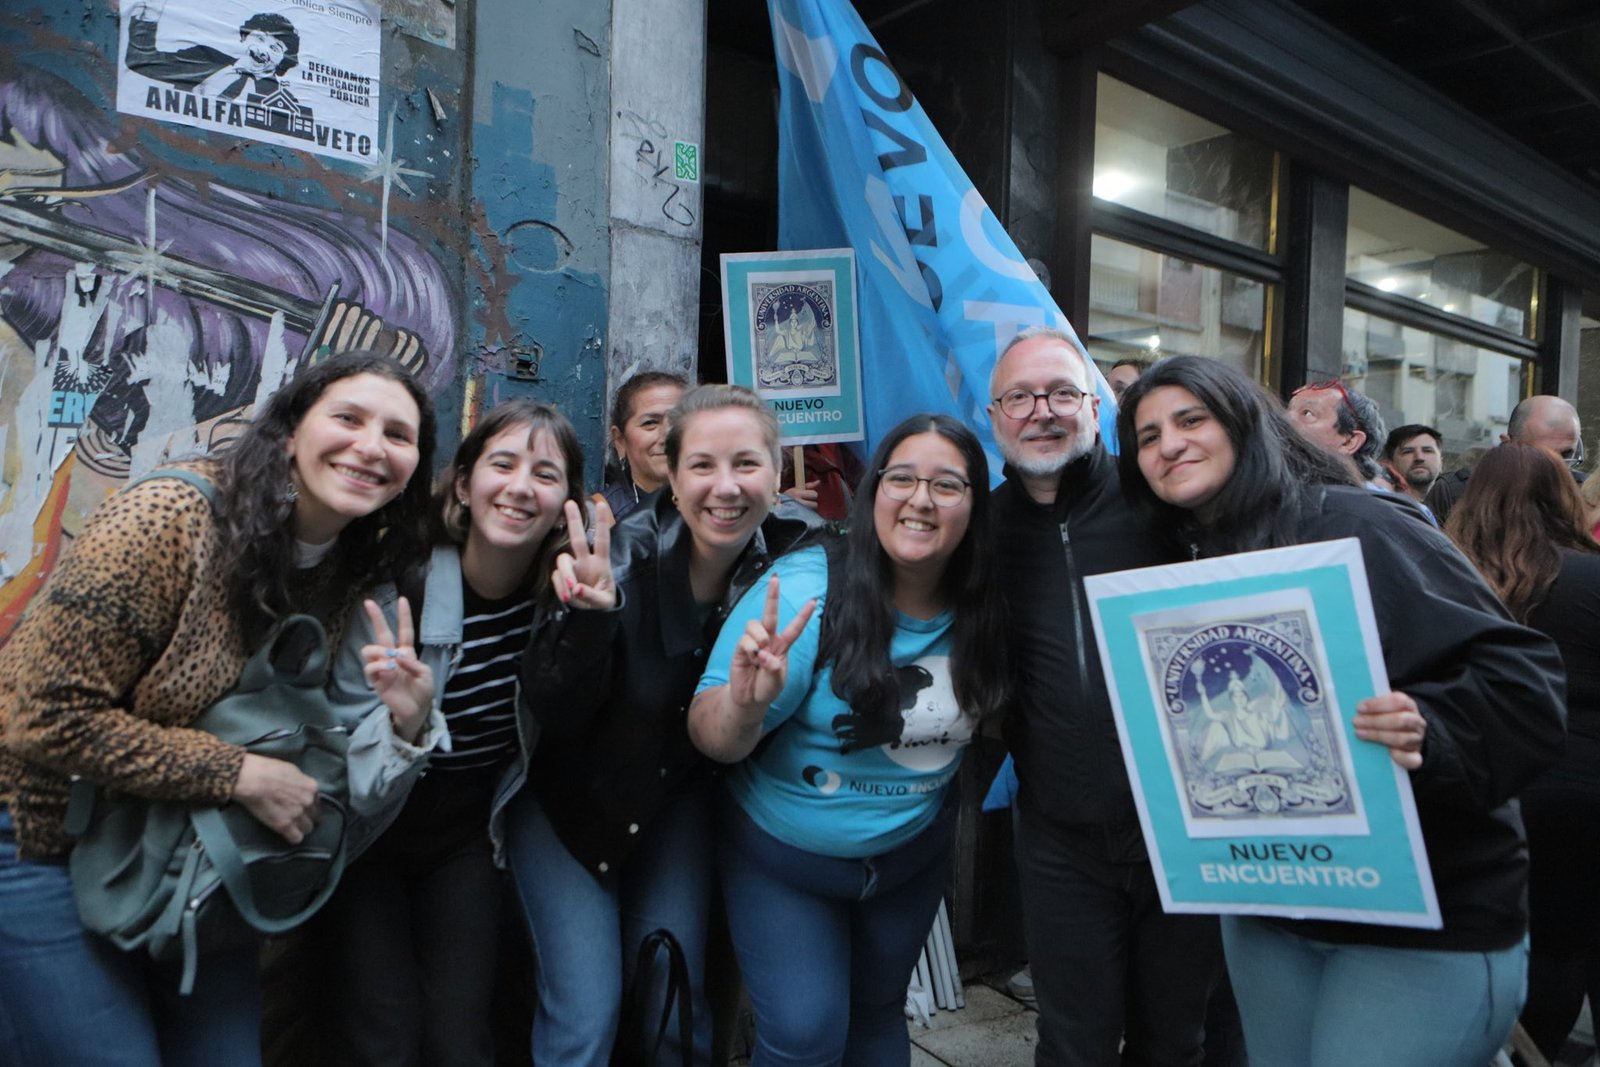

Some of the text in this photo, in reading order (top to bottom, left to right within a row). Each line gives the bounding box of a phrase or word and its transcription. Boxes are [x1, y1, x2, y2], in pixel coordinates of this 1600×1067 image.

[284, 0, 372, 26] ublica Siempre
[301, 70, 370, 96] LA EDUCACIÓN
[308, 61, 371, 85] DEFENDAMOS
[145, 86, 371, 156] ANALFA VETO
[851, 43, 943, 313] EVO
[758, 285, 829, 320] UNIVERSIDAD ARGENTINA
[774, 398, 824, 411] NUEVO
[776, 410, 842, 425] CUENTRO
[1166, 626, 1311, 695] UNIVERSIDAD ARGENTINA
[851, 780, 907, 797] NUEVO
[1230, 843, 1333, 863] NUEVO
[1201, 863, 1381, 888] ENCUENTRO
